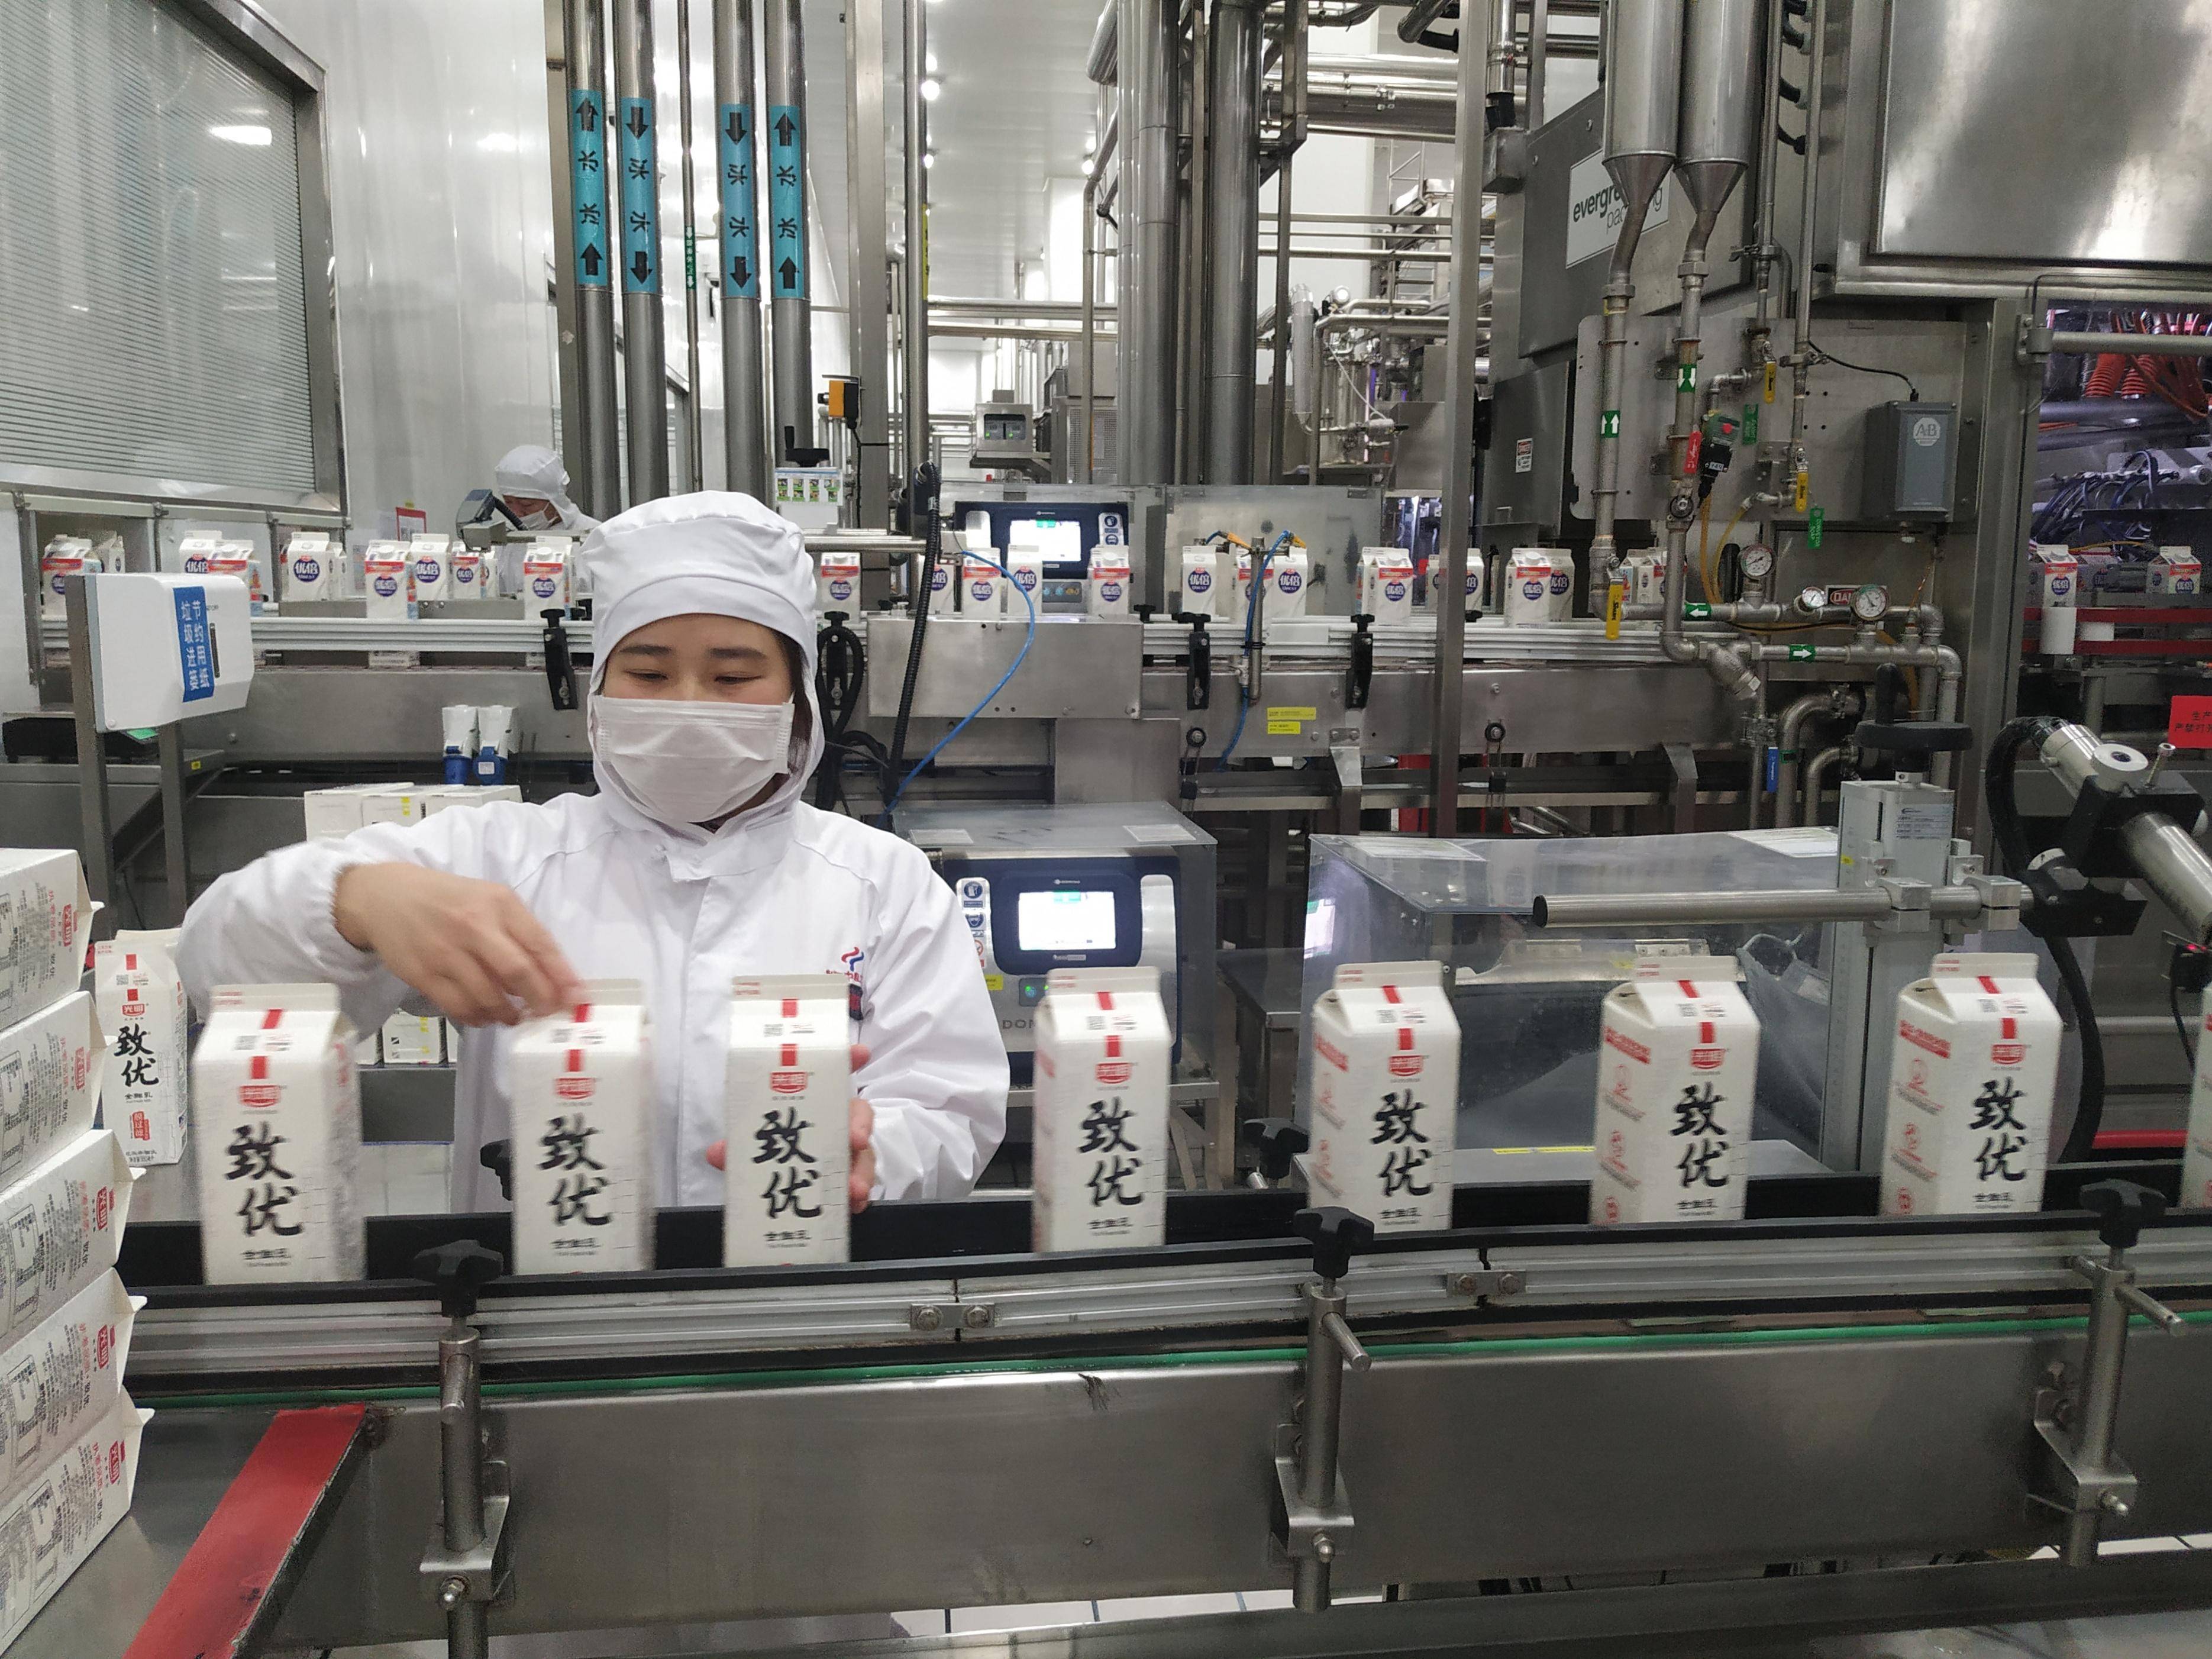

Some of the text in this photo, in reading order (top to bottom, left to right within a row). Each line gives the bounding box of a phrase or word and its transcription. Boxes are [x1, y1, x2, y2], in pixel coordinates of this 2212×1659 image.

[1573, 185, 1621, 222] evergr
[1915, 424, 1937, 437] AB
[1189, 575, 1209, 586] 优倍
[1280, 575, 1300, 586] 优倍
[114, 1023, 159, 1087] 致优
[225, 1122, 303, 1237] 致优
[537, 1115, 612, 1227] 致优
[753, 1106, 823, 1219] 致优
[1077, 1097, 1145, 1208] 致优
[1369, 1089, 1434, 1198] 致优
[1669, 1082, 1731, 1189] 致优
[1968, 1076, 2027, 1182] 致优
